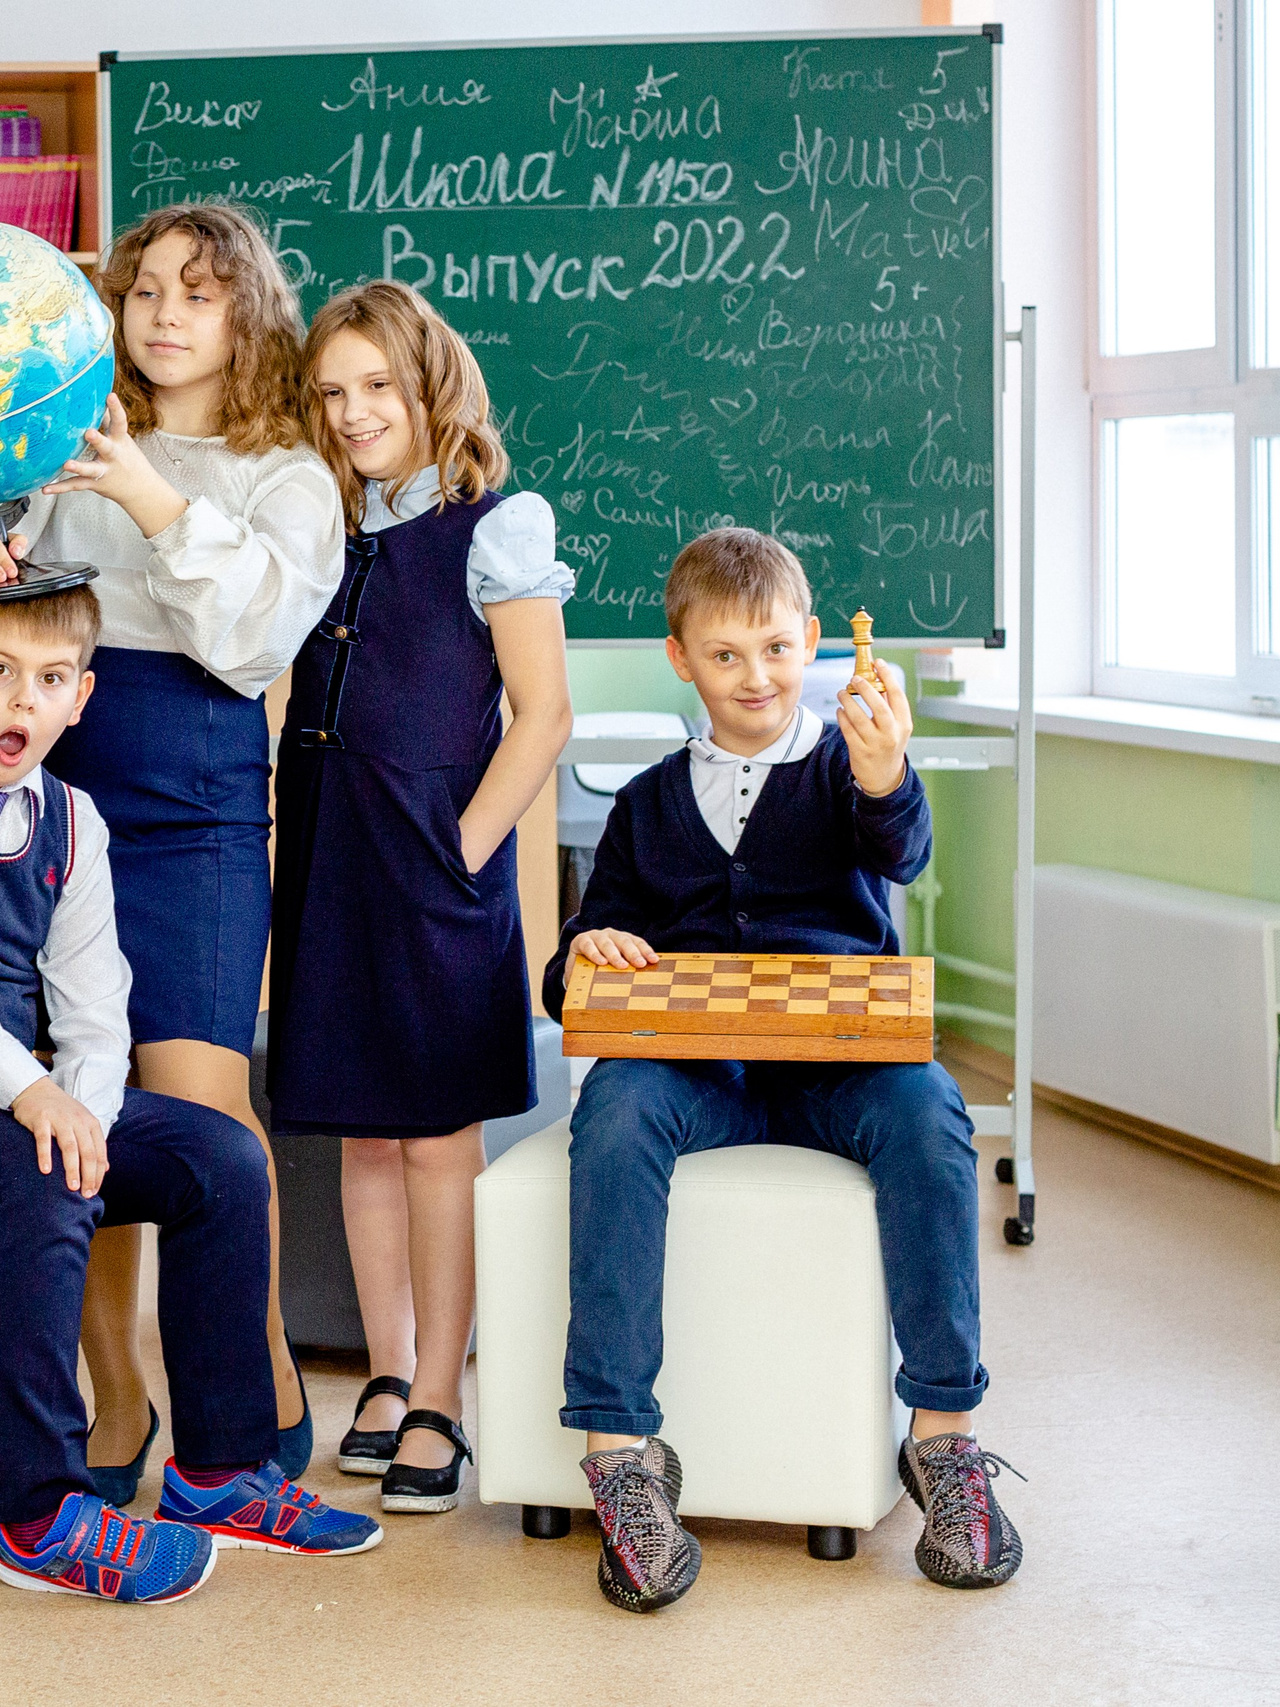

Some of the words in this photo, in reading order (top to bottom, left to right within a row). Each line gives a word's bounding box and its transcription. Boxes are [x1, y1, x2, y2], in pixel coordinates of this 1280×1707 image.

[133, 80, 242, 136] Вика
[327, 124, 565, 211] Школа
[754, 113, 953, 213] Арина
[383, 223, 633, 304] Выпуск
[642, 211, 807, 288] 2022
[758, 299, 946, 372] Вероника
[766, 463, 871, 509] Игорь
